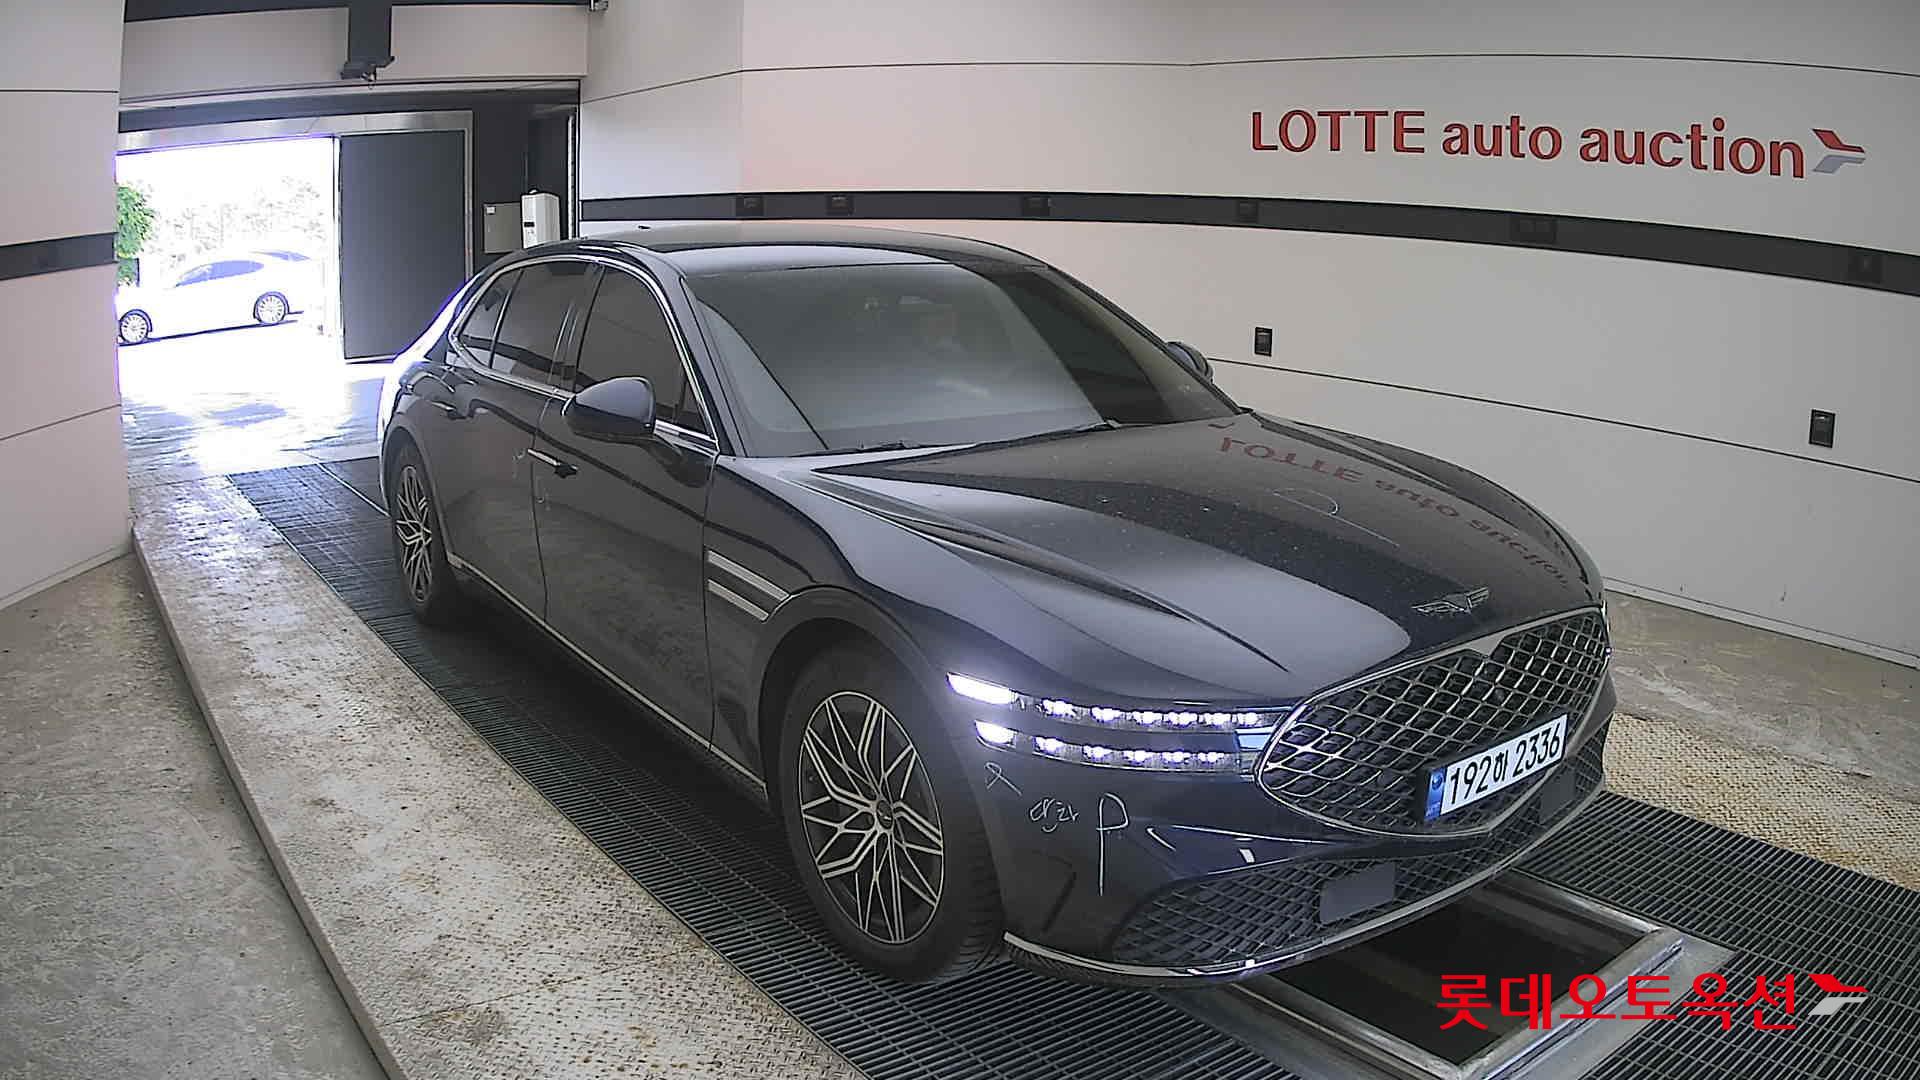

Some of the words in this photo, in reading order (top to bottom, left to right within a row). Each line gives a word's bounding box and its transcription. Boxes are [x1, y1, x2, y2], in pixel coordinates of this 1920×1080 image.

[1251, 110, 1425, 154] LOTTE
[1442, 115, 1562, 160] auto
[1579, 117, 1805, 179] auction
[1512, 722, 1561, 778] 2336
